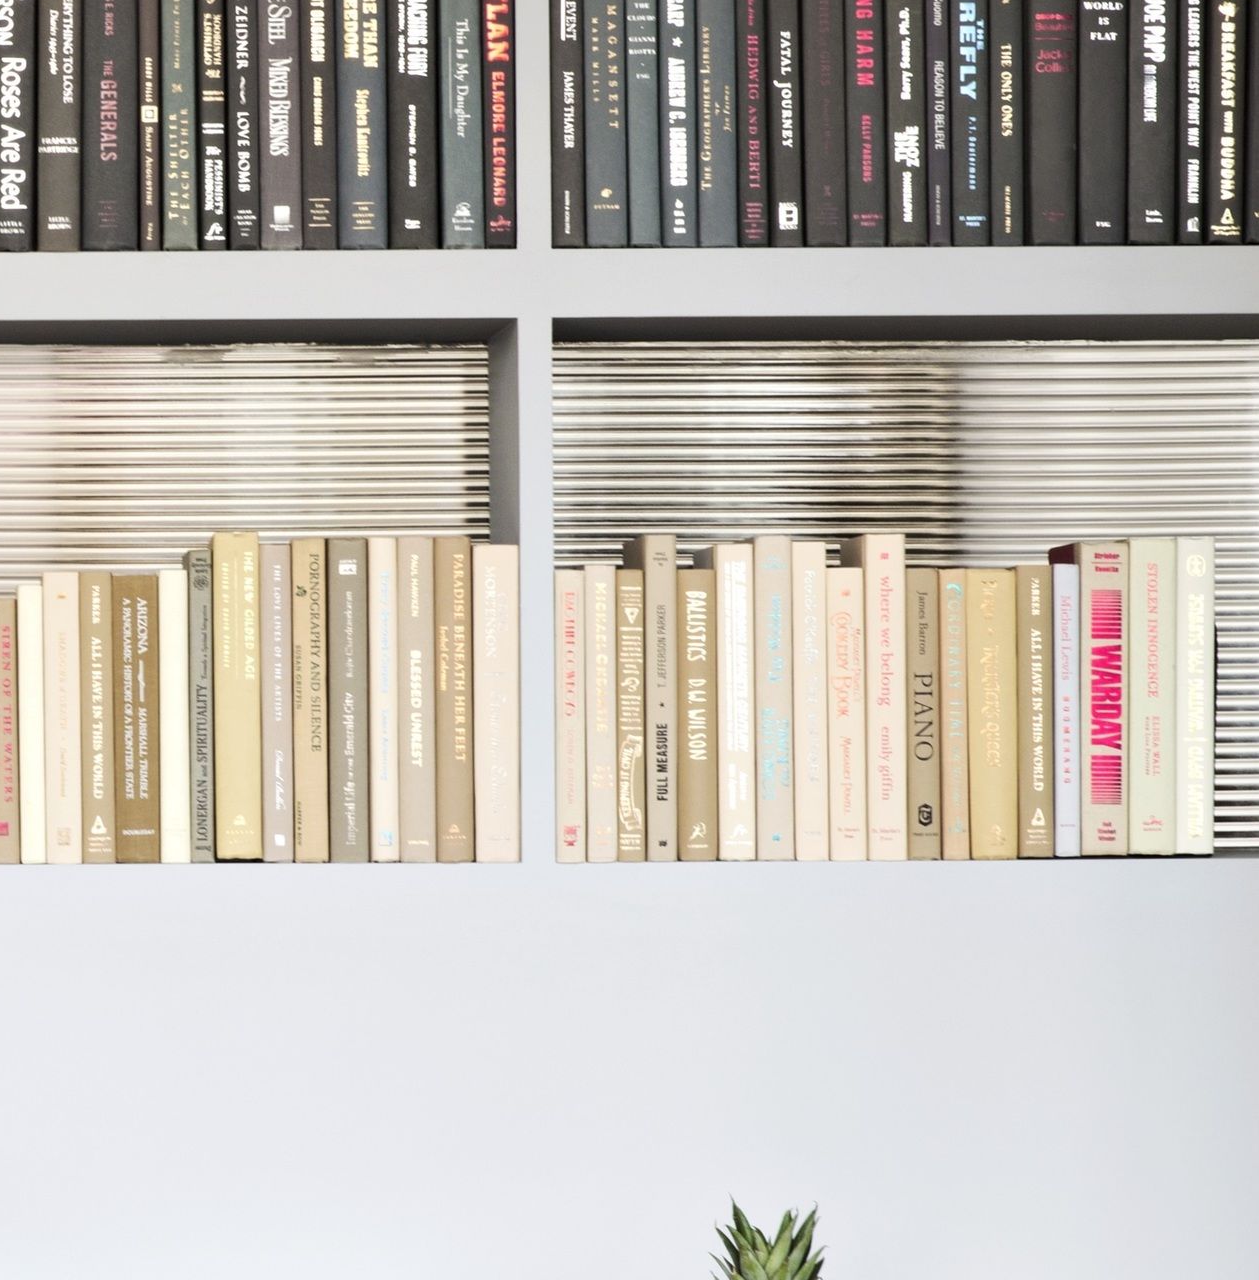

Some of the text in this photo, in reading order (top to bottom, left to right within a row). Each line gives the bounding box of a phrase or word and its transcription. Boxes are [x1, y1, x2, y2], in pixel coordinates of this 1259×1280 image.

[235, 6, 249, 70] ZEIDNER
[268, 4, 291, 44] STEEL
[362, 19, 378, 68] THAN
[566, 1, 576, 41] EVENT
[856, 30, 874, 86] HARM
[976, 19, 984, 50] THE
[1143, 26, 1166, 63] PAPP
[100, 60, 118, 161] THE GENERALS
[268, 57, 292, 97] MIXED
[454, 19, 470, 138] This Is My Daughter
[491, 71, 505, 133] ELMORE
[563, 71, 574, 104] JAMES
[747, 34, 761, 189] HEDWIG AND BERTI
[773, 30, 793, 148] FATAL JOURNEY
[934, 60, 946, 149] REASON TO BELIEVE
[1220, 21, 1235, 200] BREAKFAST WITH BUDDHA
[1, 57, 28, 209] Roses Are Red
[236, 111, 249, 147] LOVE
[269, 100, 290, 156] BLESSINGS
[563, 106, 575, 149] THAYER
[238, 152, 250, 192] BOMB
[492, 137, 506, 207] LEONARD
[137, 597, 148, 654] ARIZONA
[308, 553, 322, 753] PORNOGRAPHY AND SILENCE
[1060, 595, 1073, 681] Michael Lewis
[1147, 563, 1160, 698] STOLEN INNOCENCE
[409, 650, 422, 767] BLESSED UNREST
[684, 590, 707, 761] BALLISTICS D.W. WILSON
[877, 576, 894, 801] where we belong emily giffin
[913, 591, 933, 762] James Barron PIANO
[1091, 645, 1123, 750] WARDAY
[656, 723, 668, 802] FULL MEASURE
